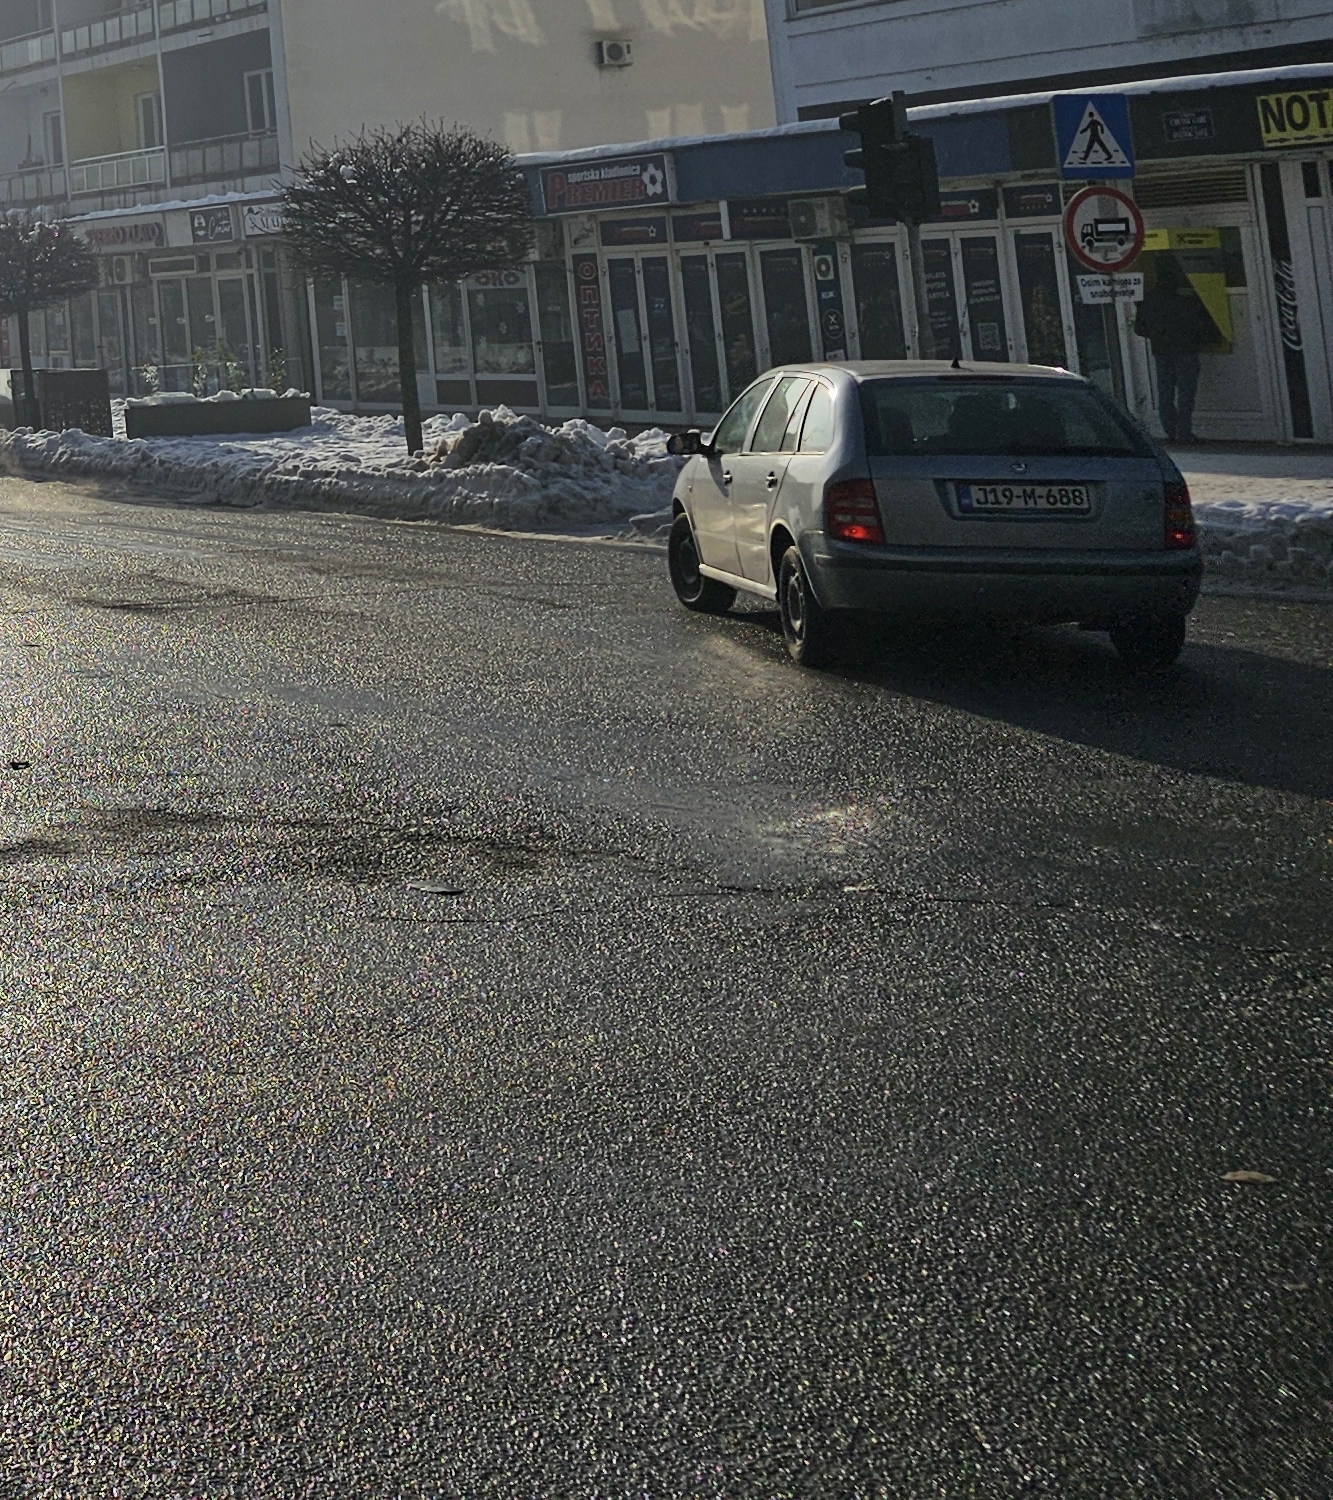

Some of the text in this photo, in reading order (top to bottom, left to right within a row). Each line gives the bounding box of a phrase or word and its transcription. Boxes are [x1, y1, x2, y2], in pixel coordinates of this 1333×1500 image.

[1261, 92, 1333, 133] NOT
[547, 171, 646, 210] PREMIER
[578, 262, 609, 399] ОПТИКА
[976, 487, 1085, 506] J19-M-688
